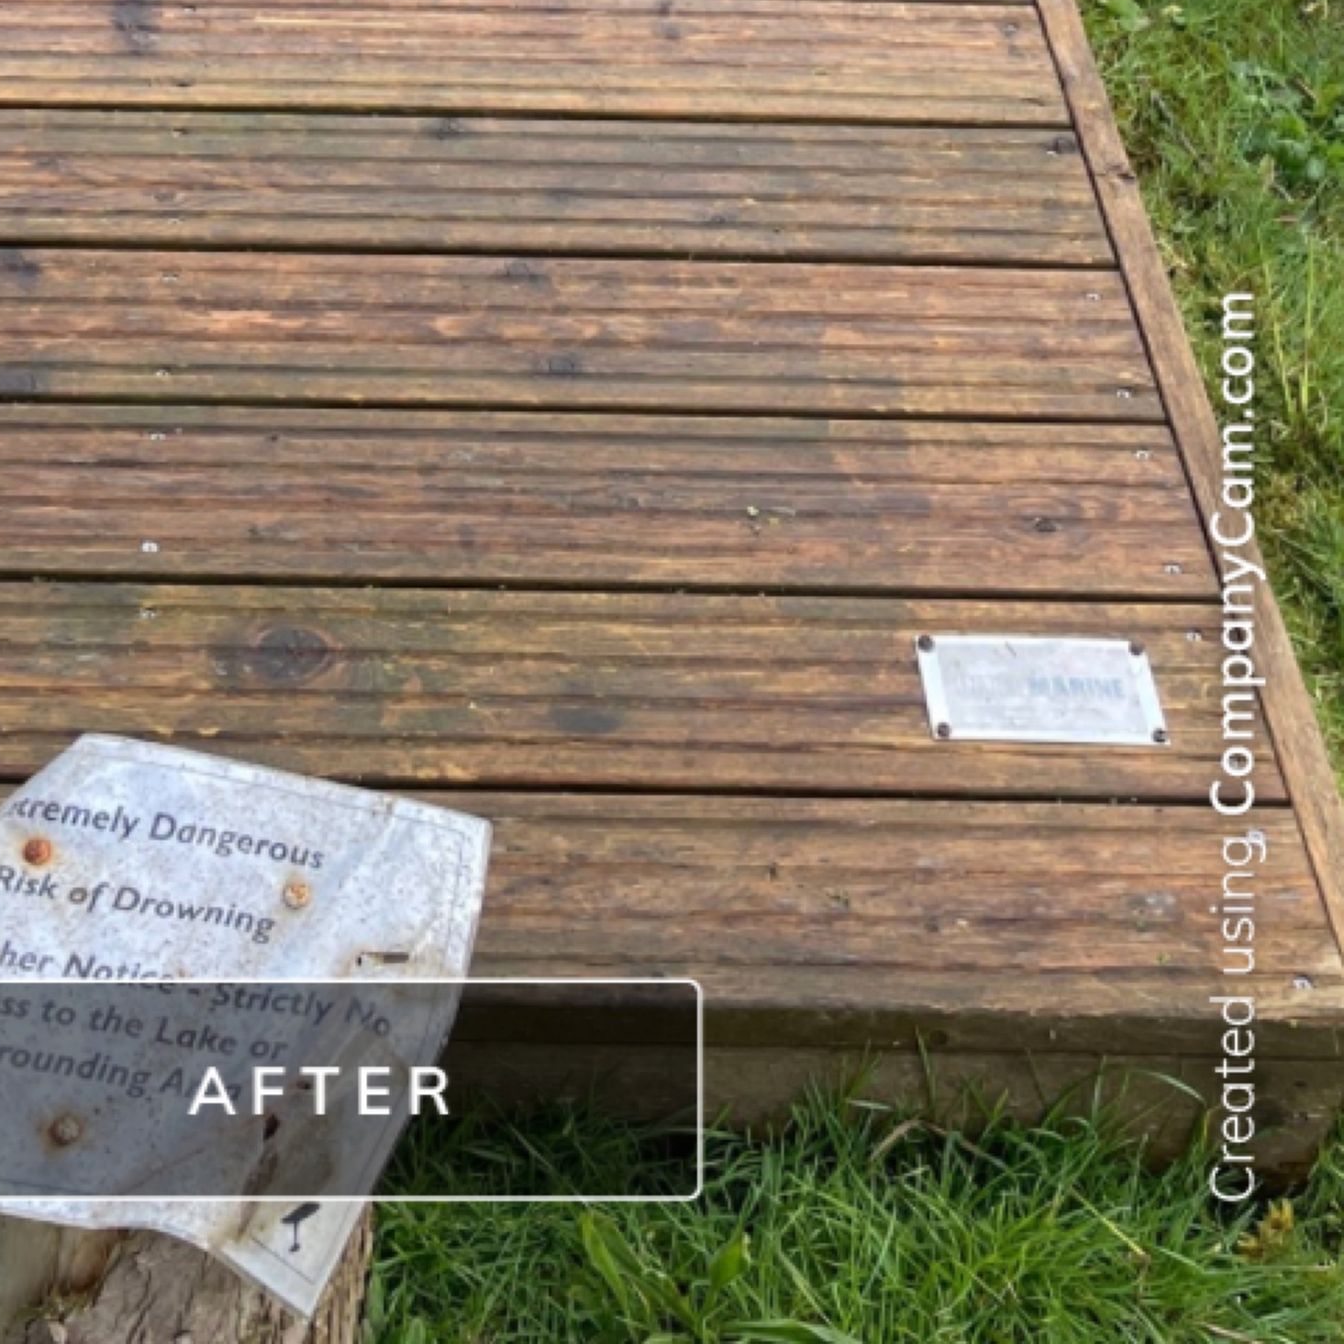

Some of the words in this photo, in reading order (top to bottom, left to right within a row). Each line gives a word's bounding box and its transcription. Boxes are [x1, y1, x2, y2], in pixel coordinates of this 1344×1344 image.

[149, 812, 325, 869] Dangerous
[67, 882, 109, 914] of
[113, 885, 276, 945] Drowning
[62, 952, 177, 996] Notice
[211, 982, 334, 1027] Strictly
[343, 997, 392, 1037] No
[41, 999, 77, 1026] to
[88, 1006, 144, 1038] the
[153, 1017, 237, 1056] Lake
[249, 1038, 289, 1062] or
